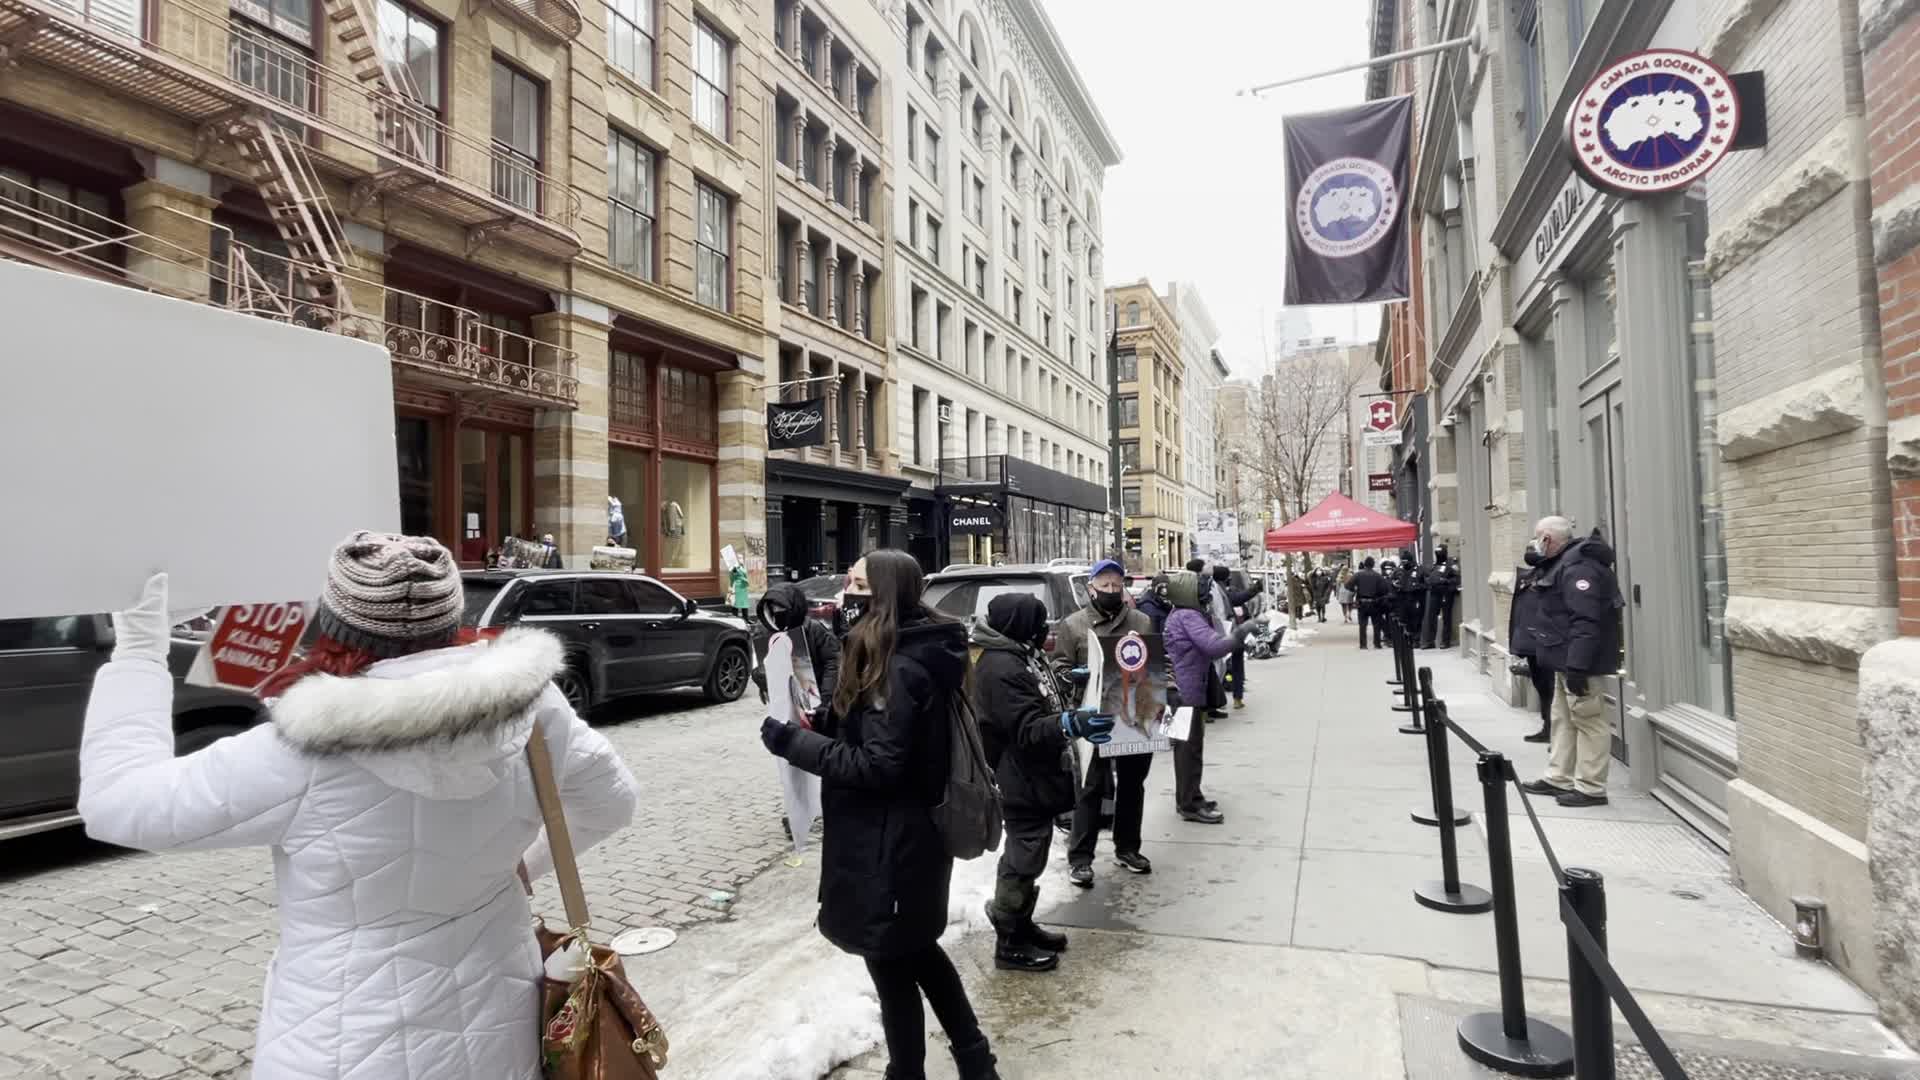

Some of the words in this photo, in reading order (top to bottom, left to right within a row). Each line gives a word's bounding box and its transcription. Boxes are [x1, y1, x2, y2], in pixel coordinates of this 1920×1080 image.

[1600, 60, 1650, 90] CANADA
[1348, 162, 1377, 175] GOSE
[1603, 165, 1650, 185] ARCTIC
[1653, 149, 1713, 183] PROGRAM
[1310, 238, 1338, 252] ACTIC
[952, 517, 991, 526] CHANEL
[233, 604, 304, 634] STOP
[227, 628, 281, 654] KILLING
[214, 646, 278, 673] ANIMALS
